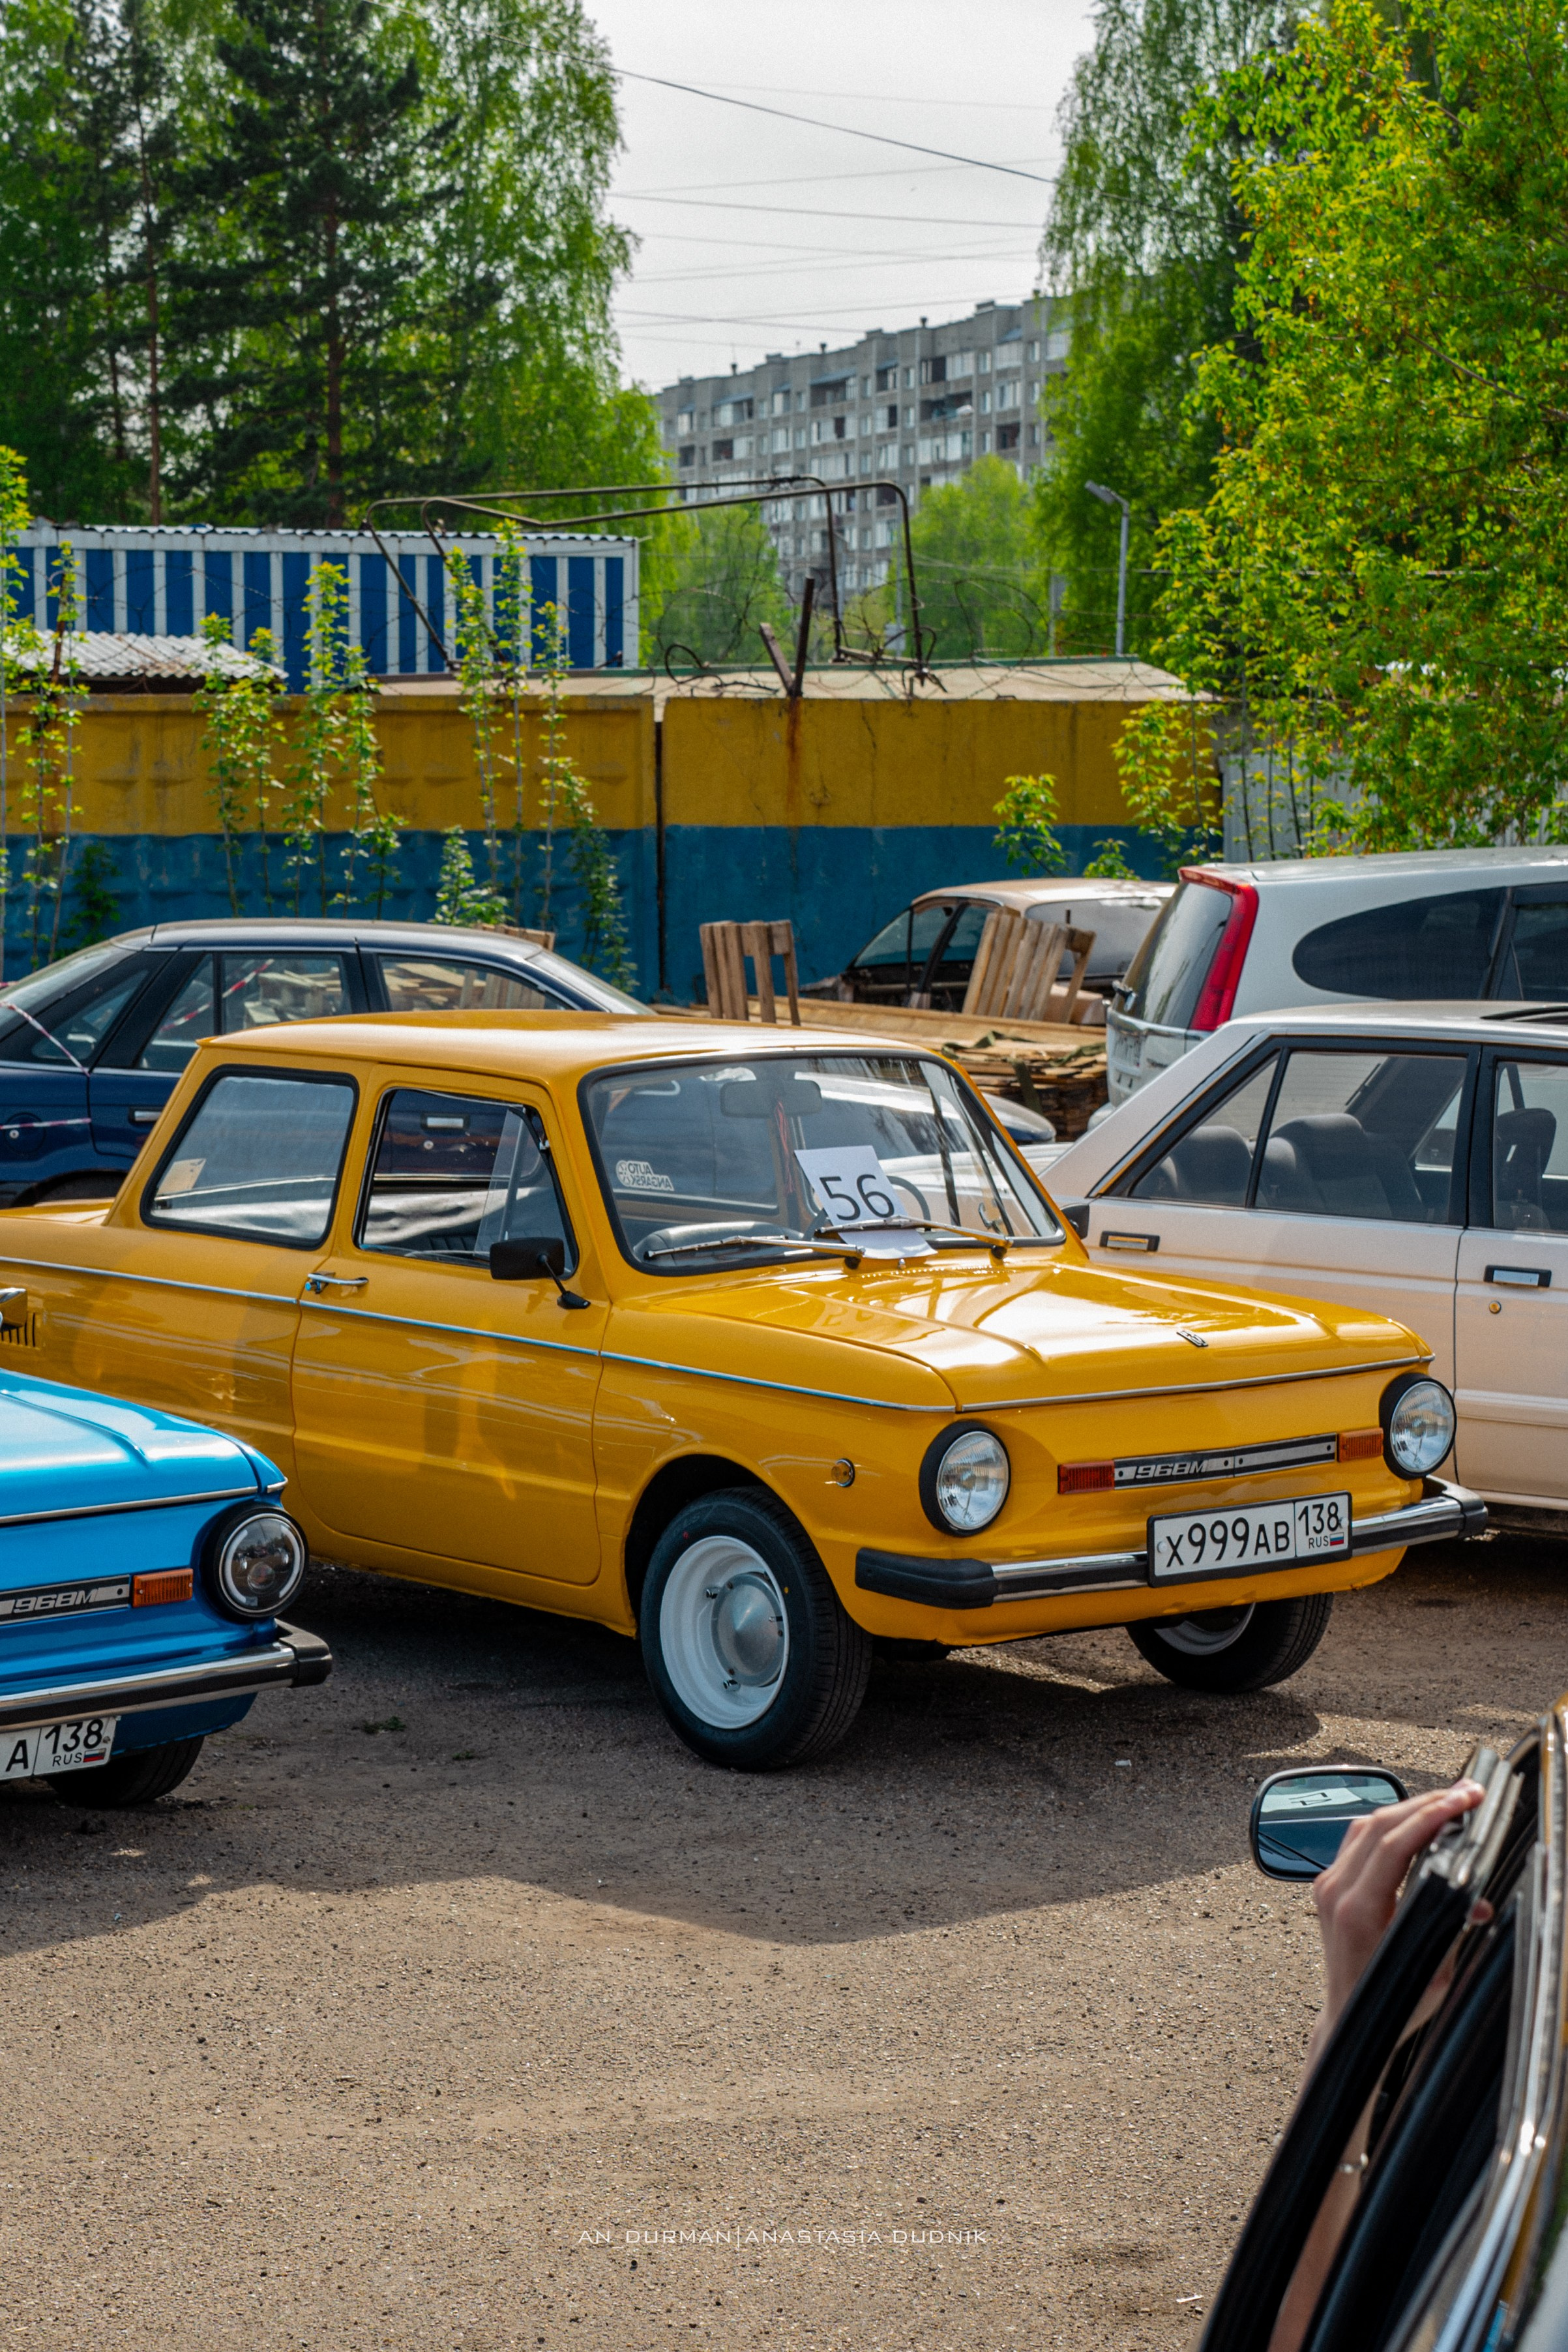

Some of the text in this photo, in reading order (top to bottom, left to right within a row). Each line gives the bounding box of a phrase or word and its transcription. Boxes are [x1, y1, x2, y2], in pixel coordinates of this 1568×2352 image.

[820, 1174, 895, 1221] 56
[1136, 1459, 1208, 1479] 968M
[1166, 1502, 1339, 1568] X999AB 138
[1309, 1536, 1329, 1549] RUS
[13, 1588, 98, 1614] 968M
[45, 1719, 104, 1754] 138
[52, 1752, 82, 1766] RUS
